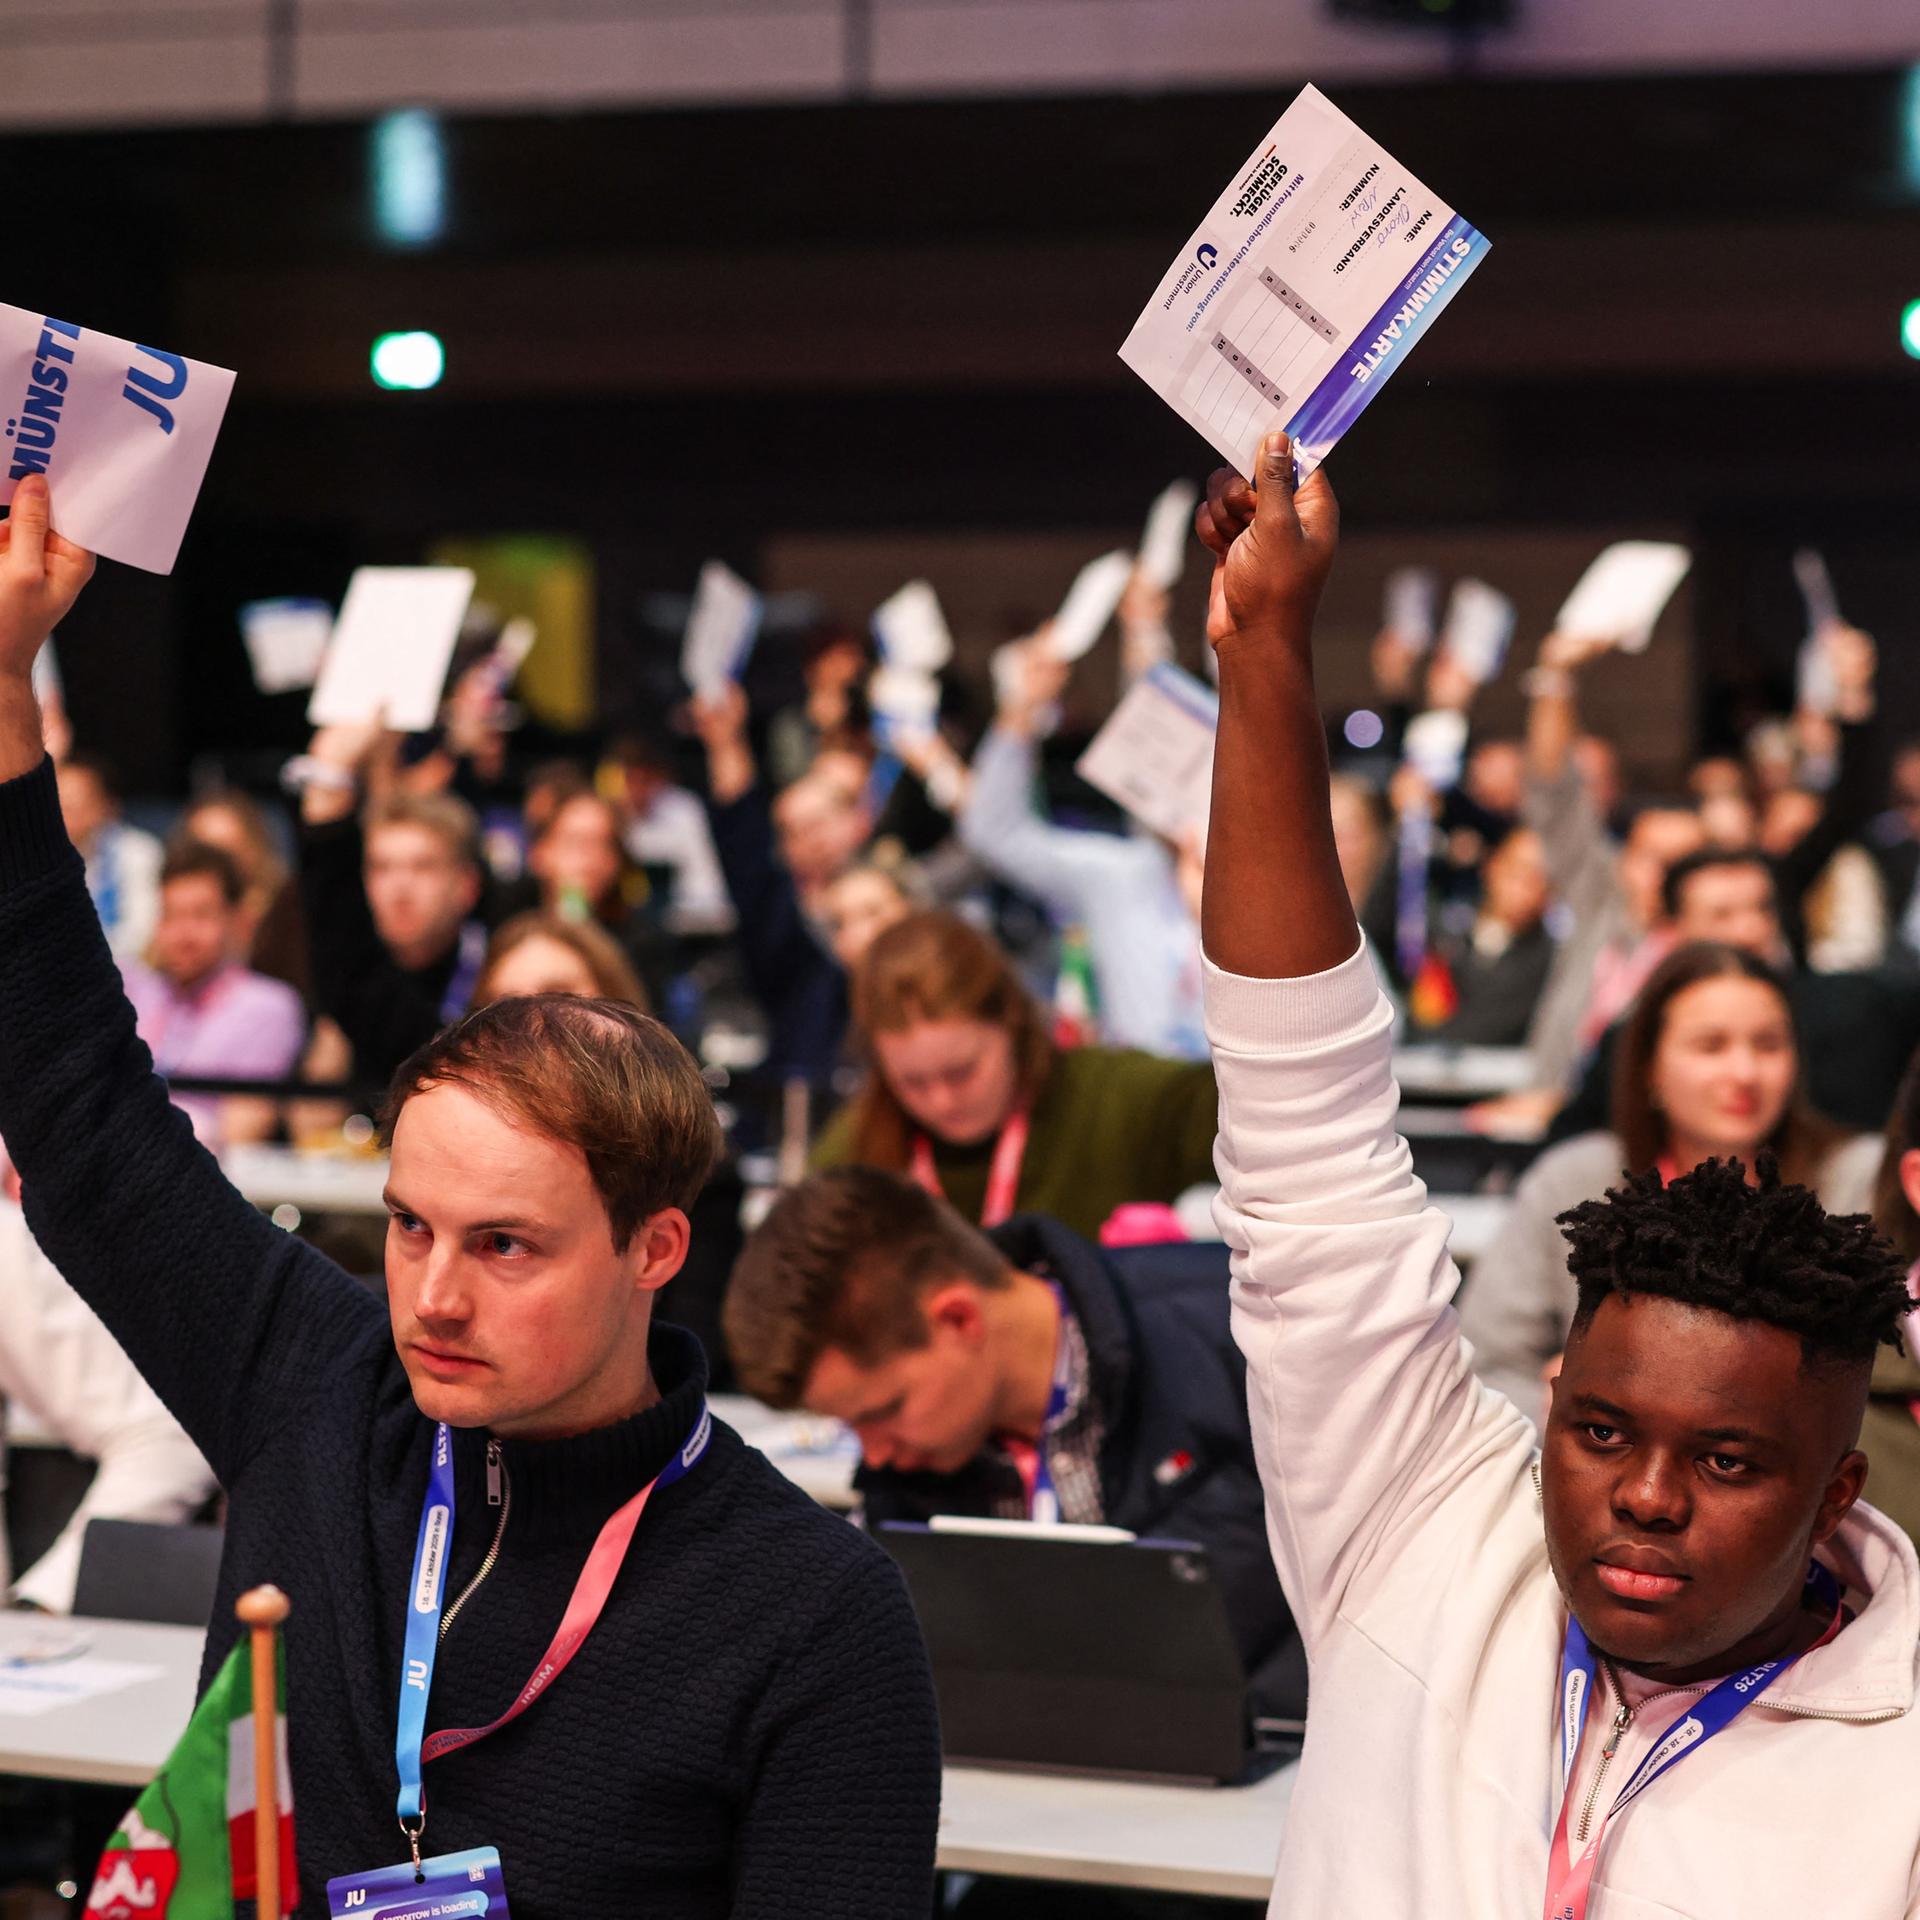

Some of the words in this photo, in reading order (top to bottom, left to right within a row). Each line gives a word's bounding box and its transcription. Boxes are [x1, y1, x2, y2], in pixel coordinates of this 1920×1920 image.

[1229, 155, 1280, 217] SCHMECKT.
[1243, 164, 1288, 217] GEFLÜGEL
[1288, 173, 1305, 191] Mit
[1339, 163, 1380, 211] NUMMER:
[1246, 189, 1292, 247] freundlicher
[1403, 210, 1433, 243] NAME:
[1333, 187, 1406, 274] LANDESVERBAND:
[1444, 228, 1455, 241] Bei
[1429, 238, 1448, 258] Verlust
[1420, 255, 1434, 268] kein
[1163, 262, 1197, 310] Investment
[1183, 269, 1204, 295] Union
[1197, 246, 1249, 313] Unterstützung
[1266, 275, 1273, 283] 5
[1295, 302, 1302, 310] 3
[1350, 237, 1471, 384] STIMMKARTE
[1185, 311, 1201, 333] von:
[1310, 315, 1317, 323] 2
[1217, 338, 1226, 350] 10
[1245, 367, 1252, 375] 8
[1260, 381, 1266, 389] 7
[407, 1659, 428, 1691] JU
[521, 1663, 554, 1704] INSM
[1734, 1663, 1777, 1693] DLT26
[345, 1889, 366, 1908] JU
[431, 1906, 441, 1916] is
